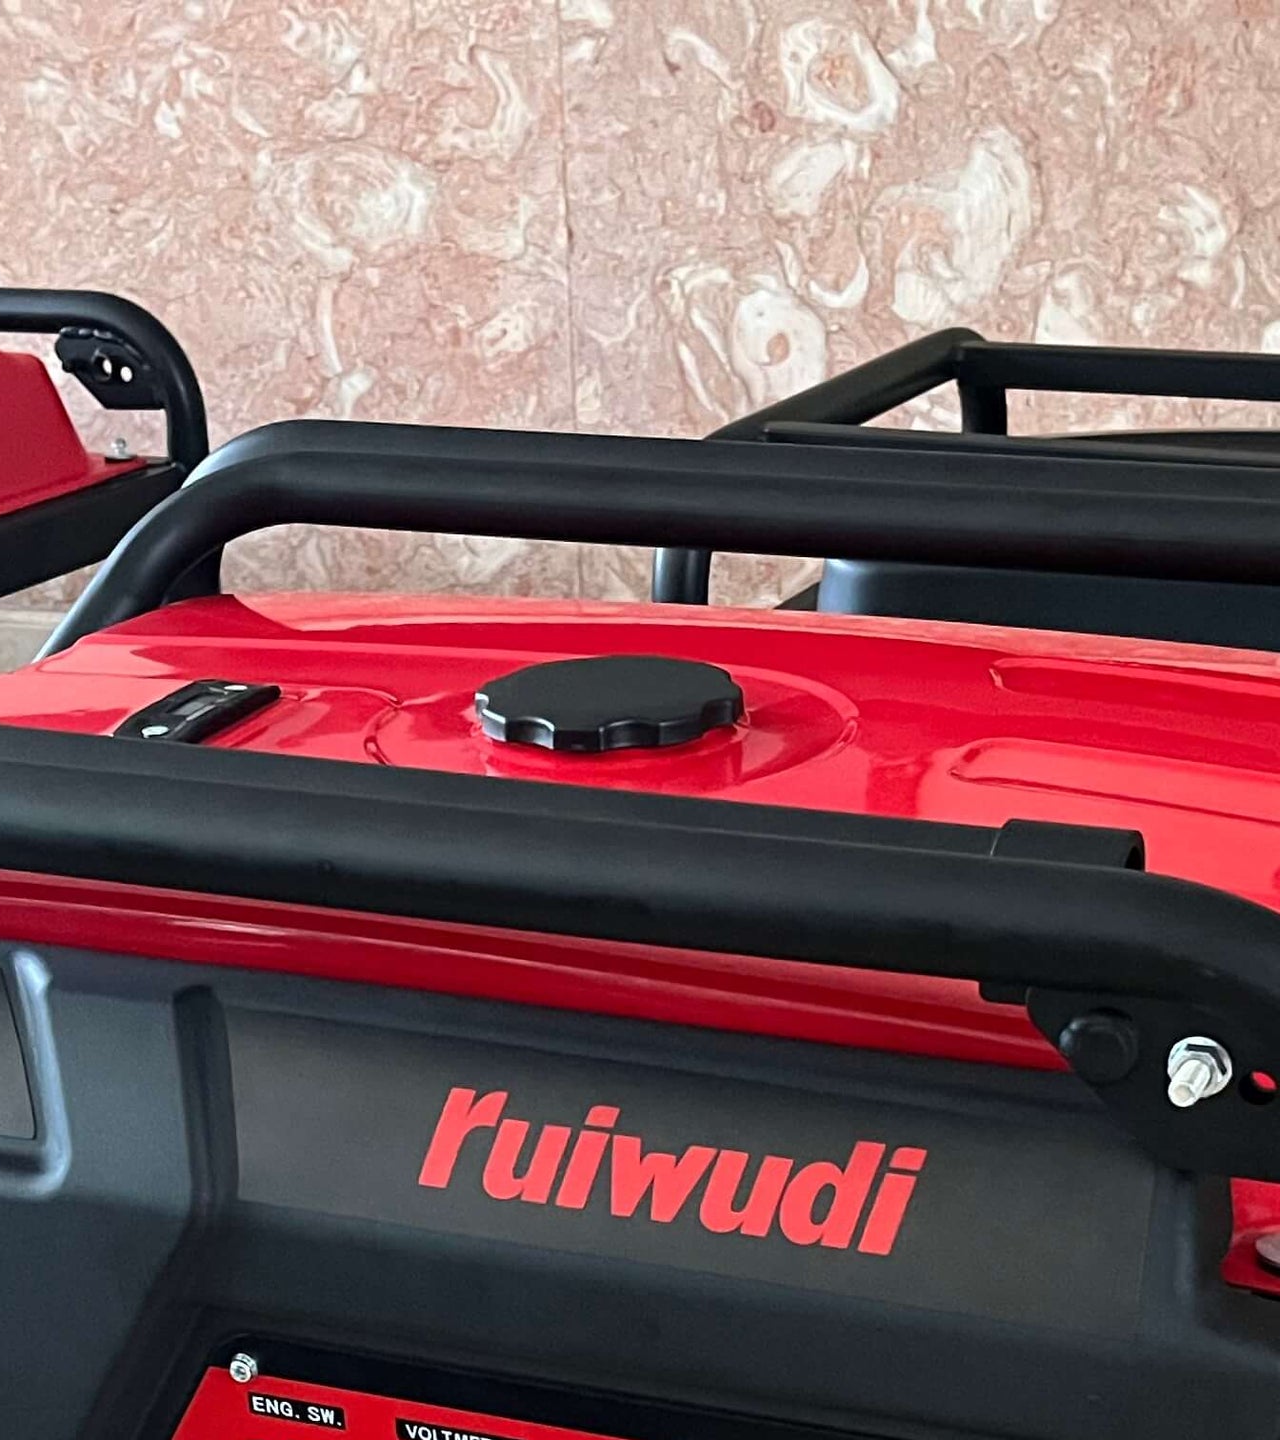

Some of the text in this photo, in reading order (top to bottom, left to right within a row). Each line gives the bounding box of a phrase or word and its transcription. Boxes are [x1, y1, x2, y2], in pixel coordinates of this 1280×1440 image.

[418, 1086, 928, 1256] ruiwudi
[252, 1396, 342, 1427] ENG. SW.
